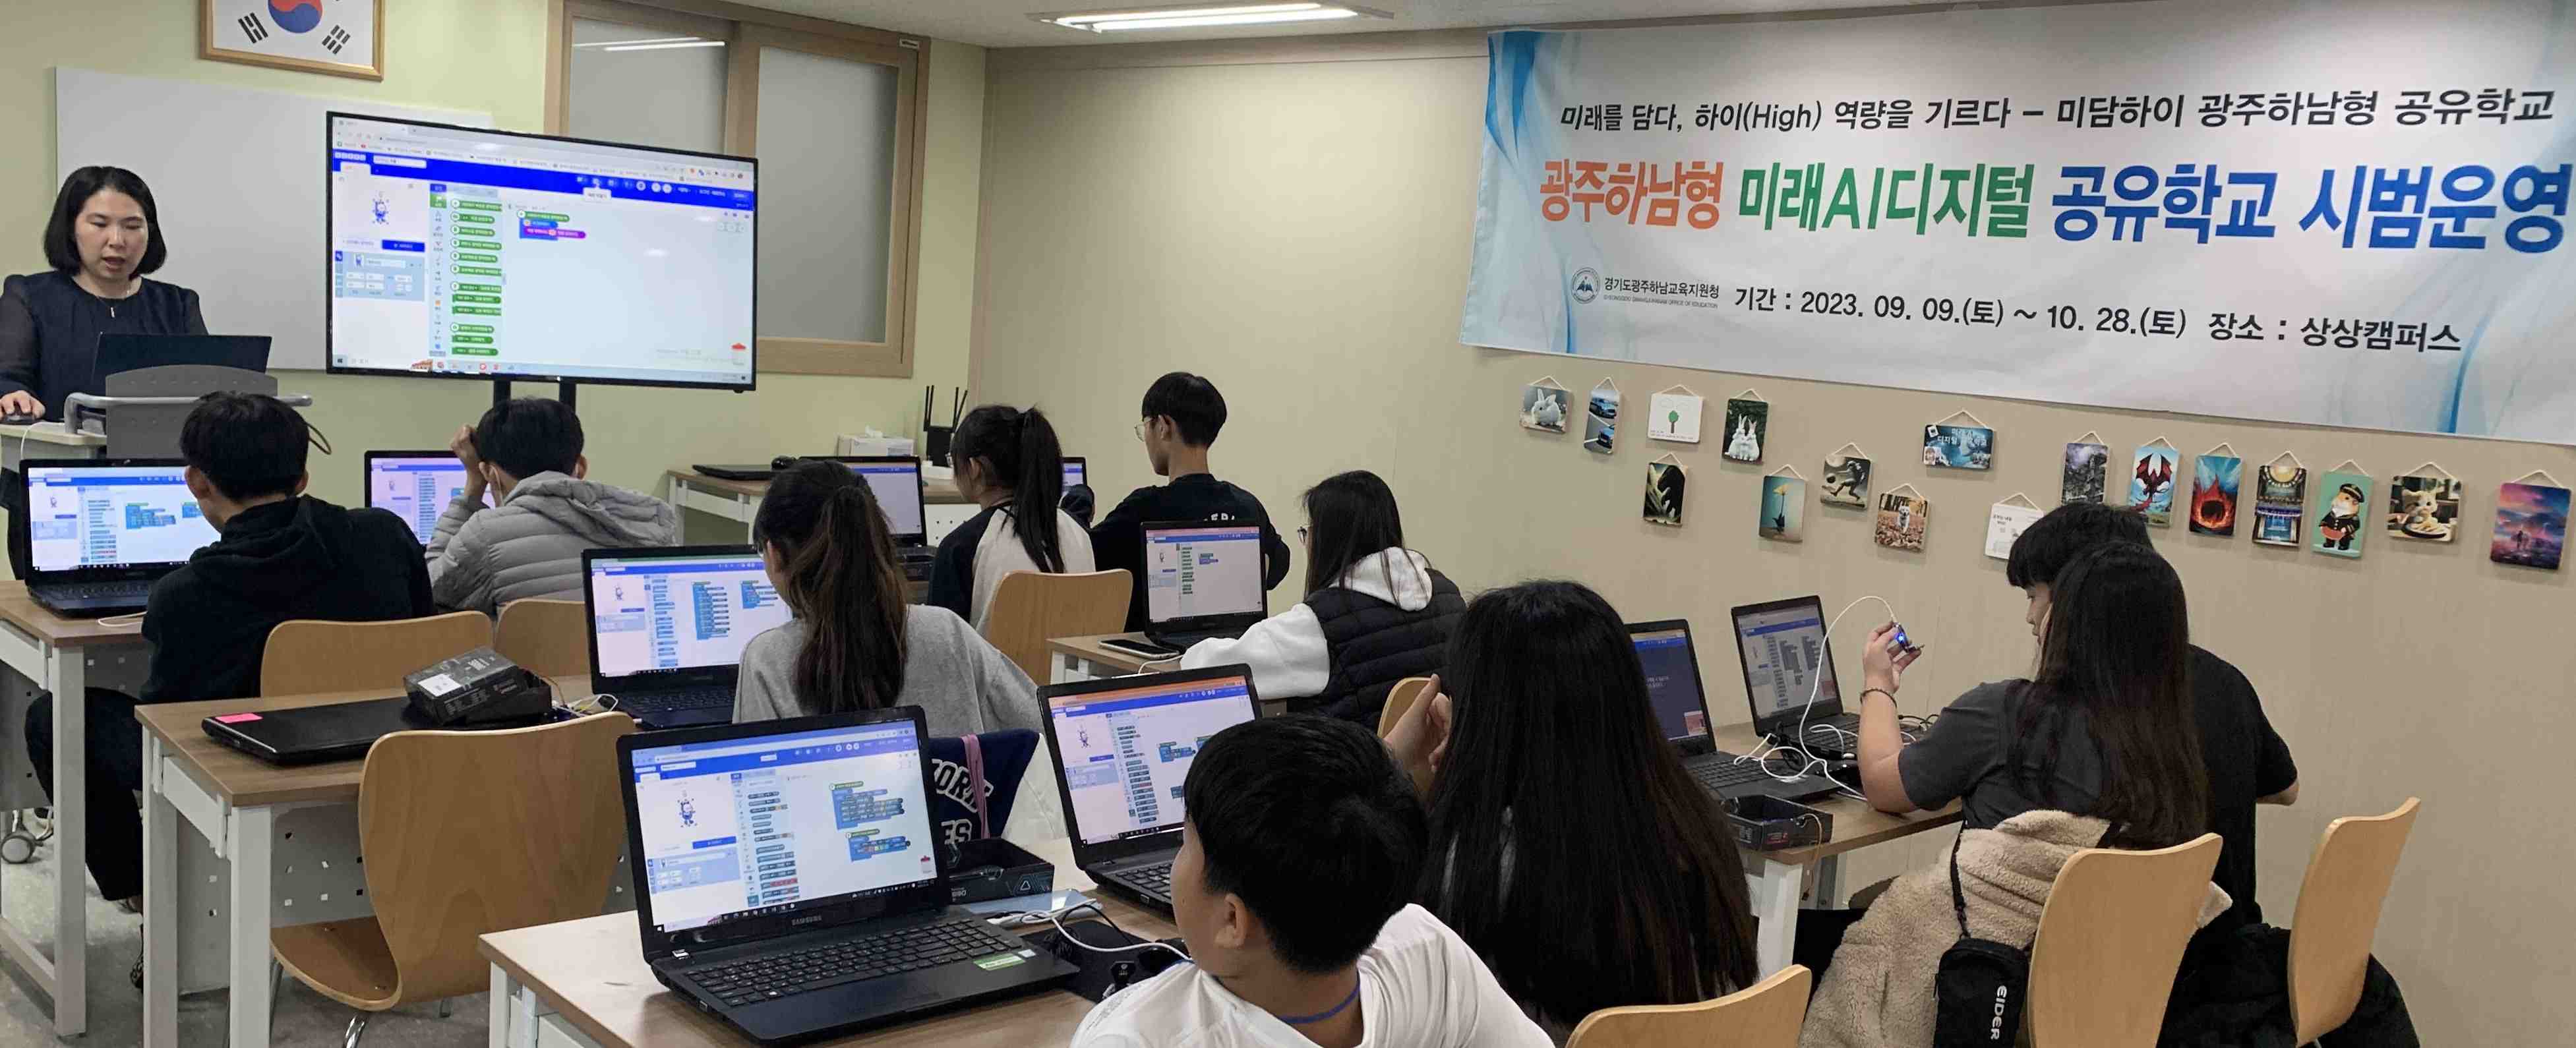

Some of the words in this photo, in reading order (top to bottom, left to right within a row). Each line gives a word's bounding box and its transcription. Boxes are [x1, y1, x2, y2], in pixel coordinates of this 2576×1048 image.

[1561, 103, 1623, 131] 미래를
[1632, 103, 1683, 132] 담다,
[1694, 100, 1822, 132] 하이(High)
[1834, 98, 1913, 130] 역량을
[1925, 97, 2011, 129] 기르다
[2057, 95, 2185, 129] 미담하이
[2198, 90, 2379, 128] 광주하남형
[2393, 88, 2555, 126] 공유학교
[1540, 158, 1724, 230] 광주하남형
[1739, 162, 2035, 239] 미래AI디지털
[2052, 163, 2279, 245] 공유학교
[2298, 161, 2574, 254] 시범운영
[1604, 277, 1720, 300] 경기도광주하남교육지원청
[1735, 286, 1777, 312] 기간
[1801, 291, 1863, 317] 2023.
[1874, 295, 1911, 320] 09.
[1923, 297, 2004, 328] 09.(토)
[2047, 305, 2084, 331] 10.
[2096, 306, 2186, 338] 28.(토)
[2209, 312, 2264, 340] 장소
[2300, 316, 2462, 353] 상상캠퍼스
[1991, 985, 2008, 1039] EIDER
